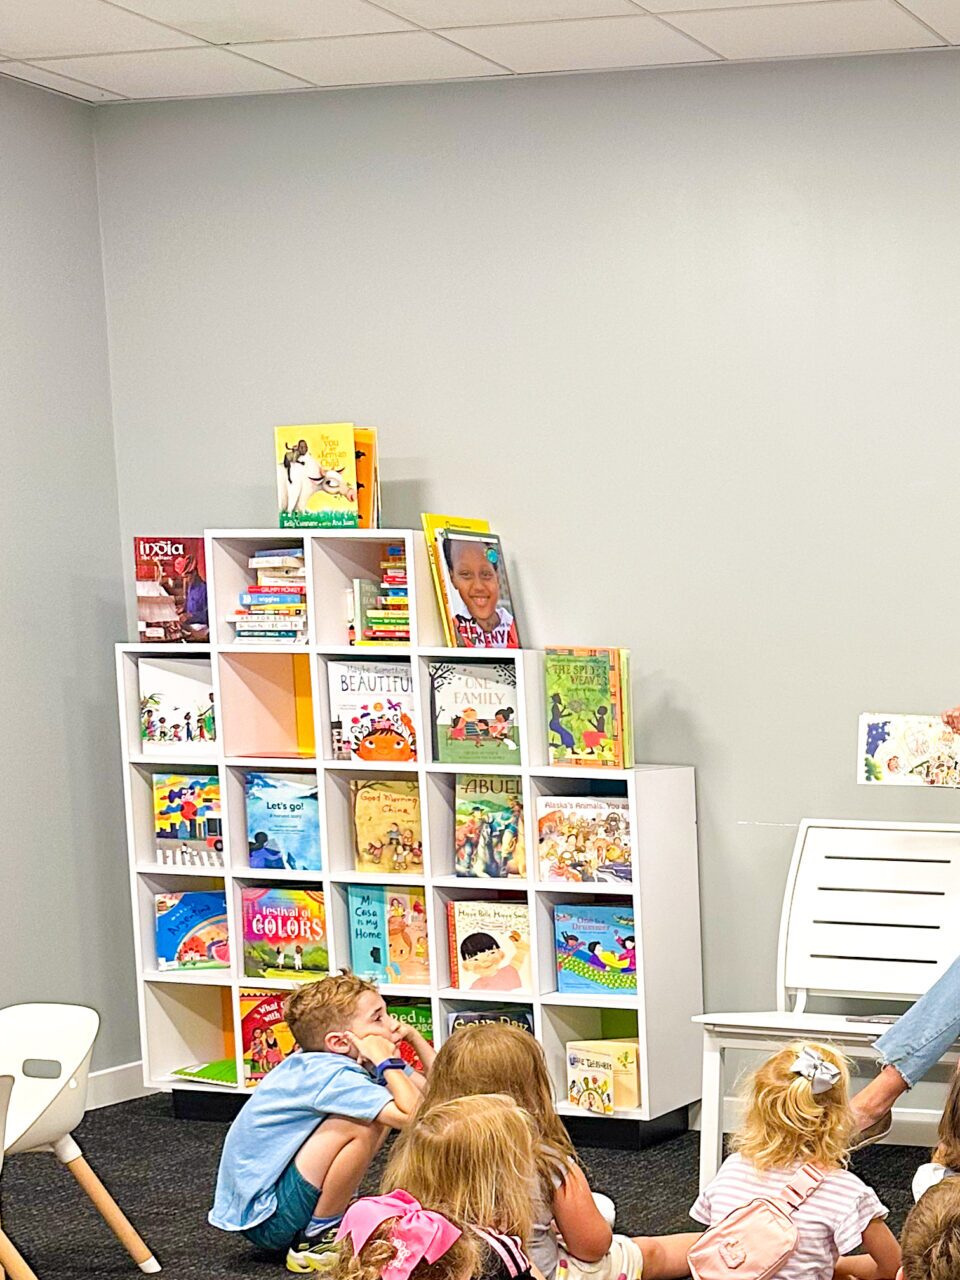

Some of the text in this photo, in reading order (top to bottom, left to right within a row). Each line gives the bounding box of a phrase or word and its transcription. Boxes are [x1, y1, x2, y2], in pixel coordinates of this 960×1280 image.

[476, 629, 515, 645] KENYA
[454, 692, 506, 705] FAMILY
[266, 802, 304, 812] Let's go!
[545, 801, 573, 809] Alaska's
[355, 907, 378, 917] Casa
[252, 914, 324, 941] COLORS
[355, 928, 382, 939] Home
